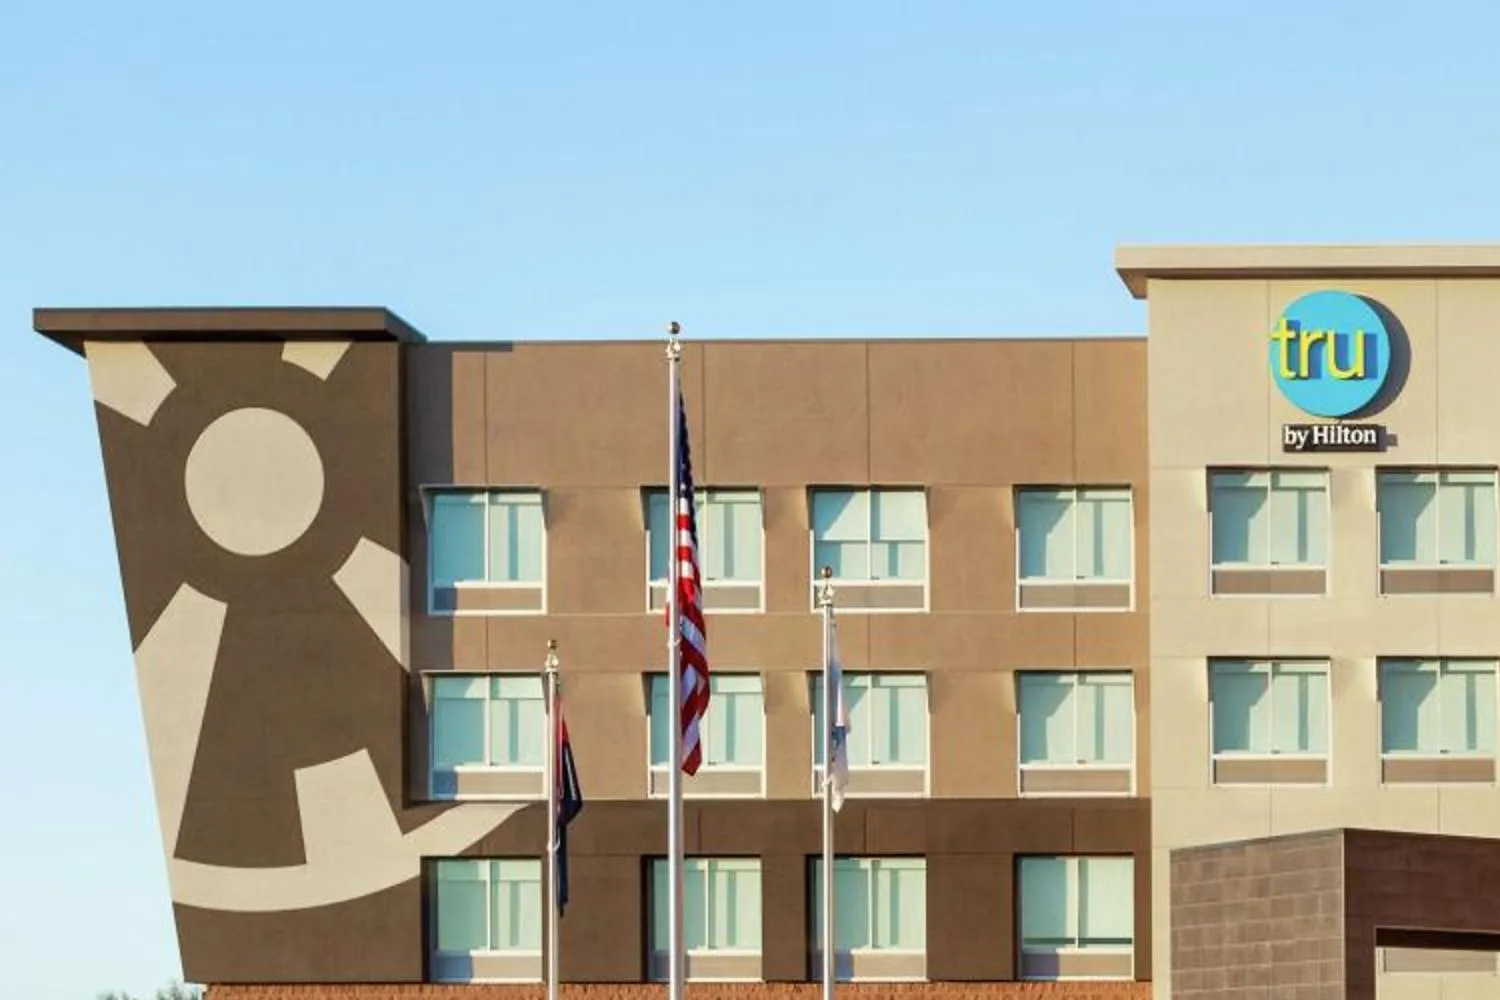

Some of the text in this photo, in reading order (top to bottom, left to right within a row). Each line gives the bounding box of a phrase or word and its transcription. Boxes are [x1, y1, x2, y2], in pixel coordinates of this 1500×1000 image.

[1270, 317, 1366, 380] tru
[1284, 425, 1376, 449] by Hilton
